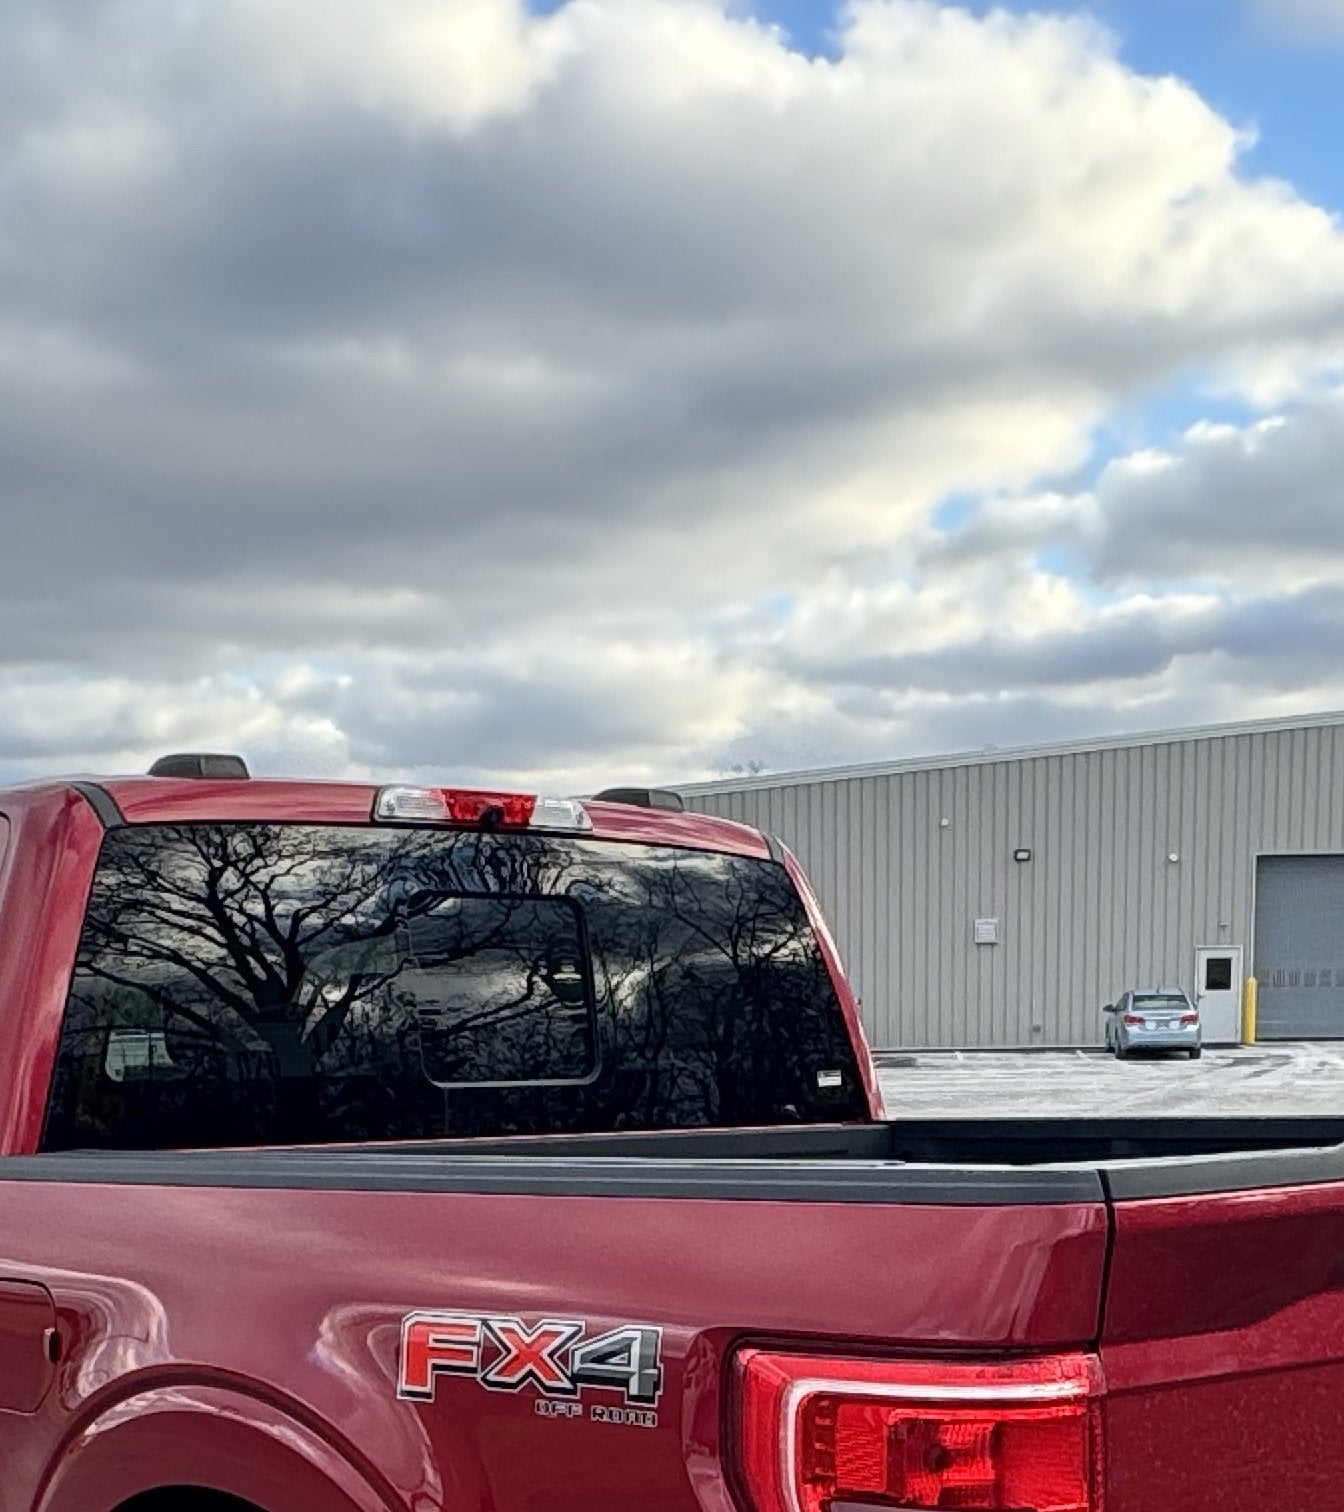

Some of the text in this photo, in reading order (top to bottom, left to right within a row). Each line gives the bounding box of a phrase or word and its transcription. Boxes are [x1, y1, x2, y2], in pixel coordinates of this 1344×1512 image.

[397, 1310, 664, 1406] FX4
[535, 1399, 658, 1428] OFF ROAD
